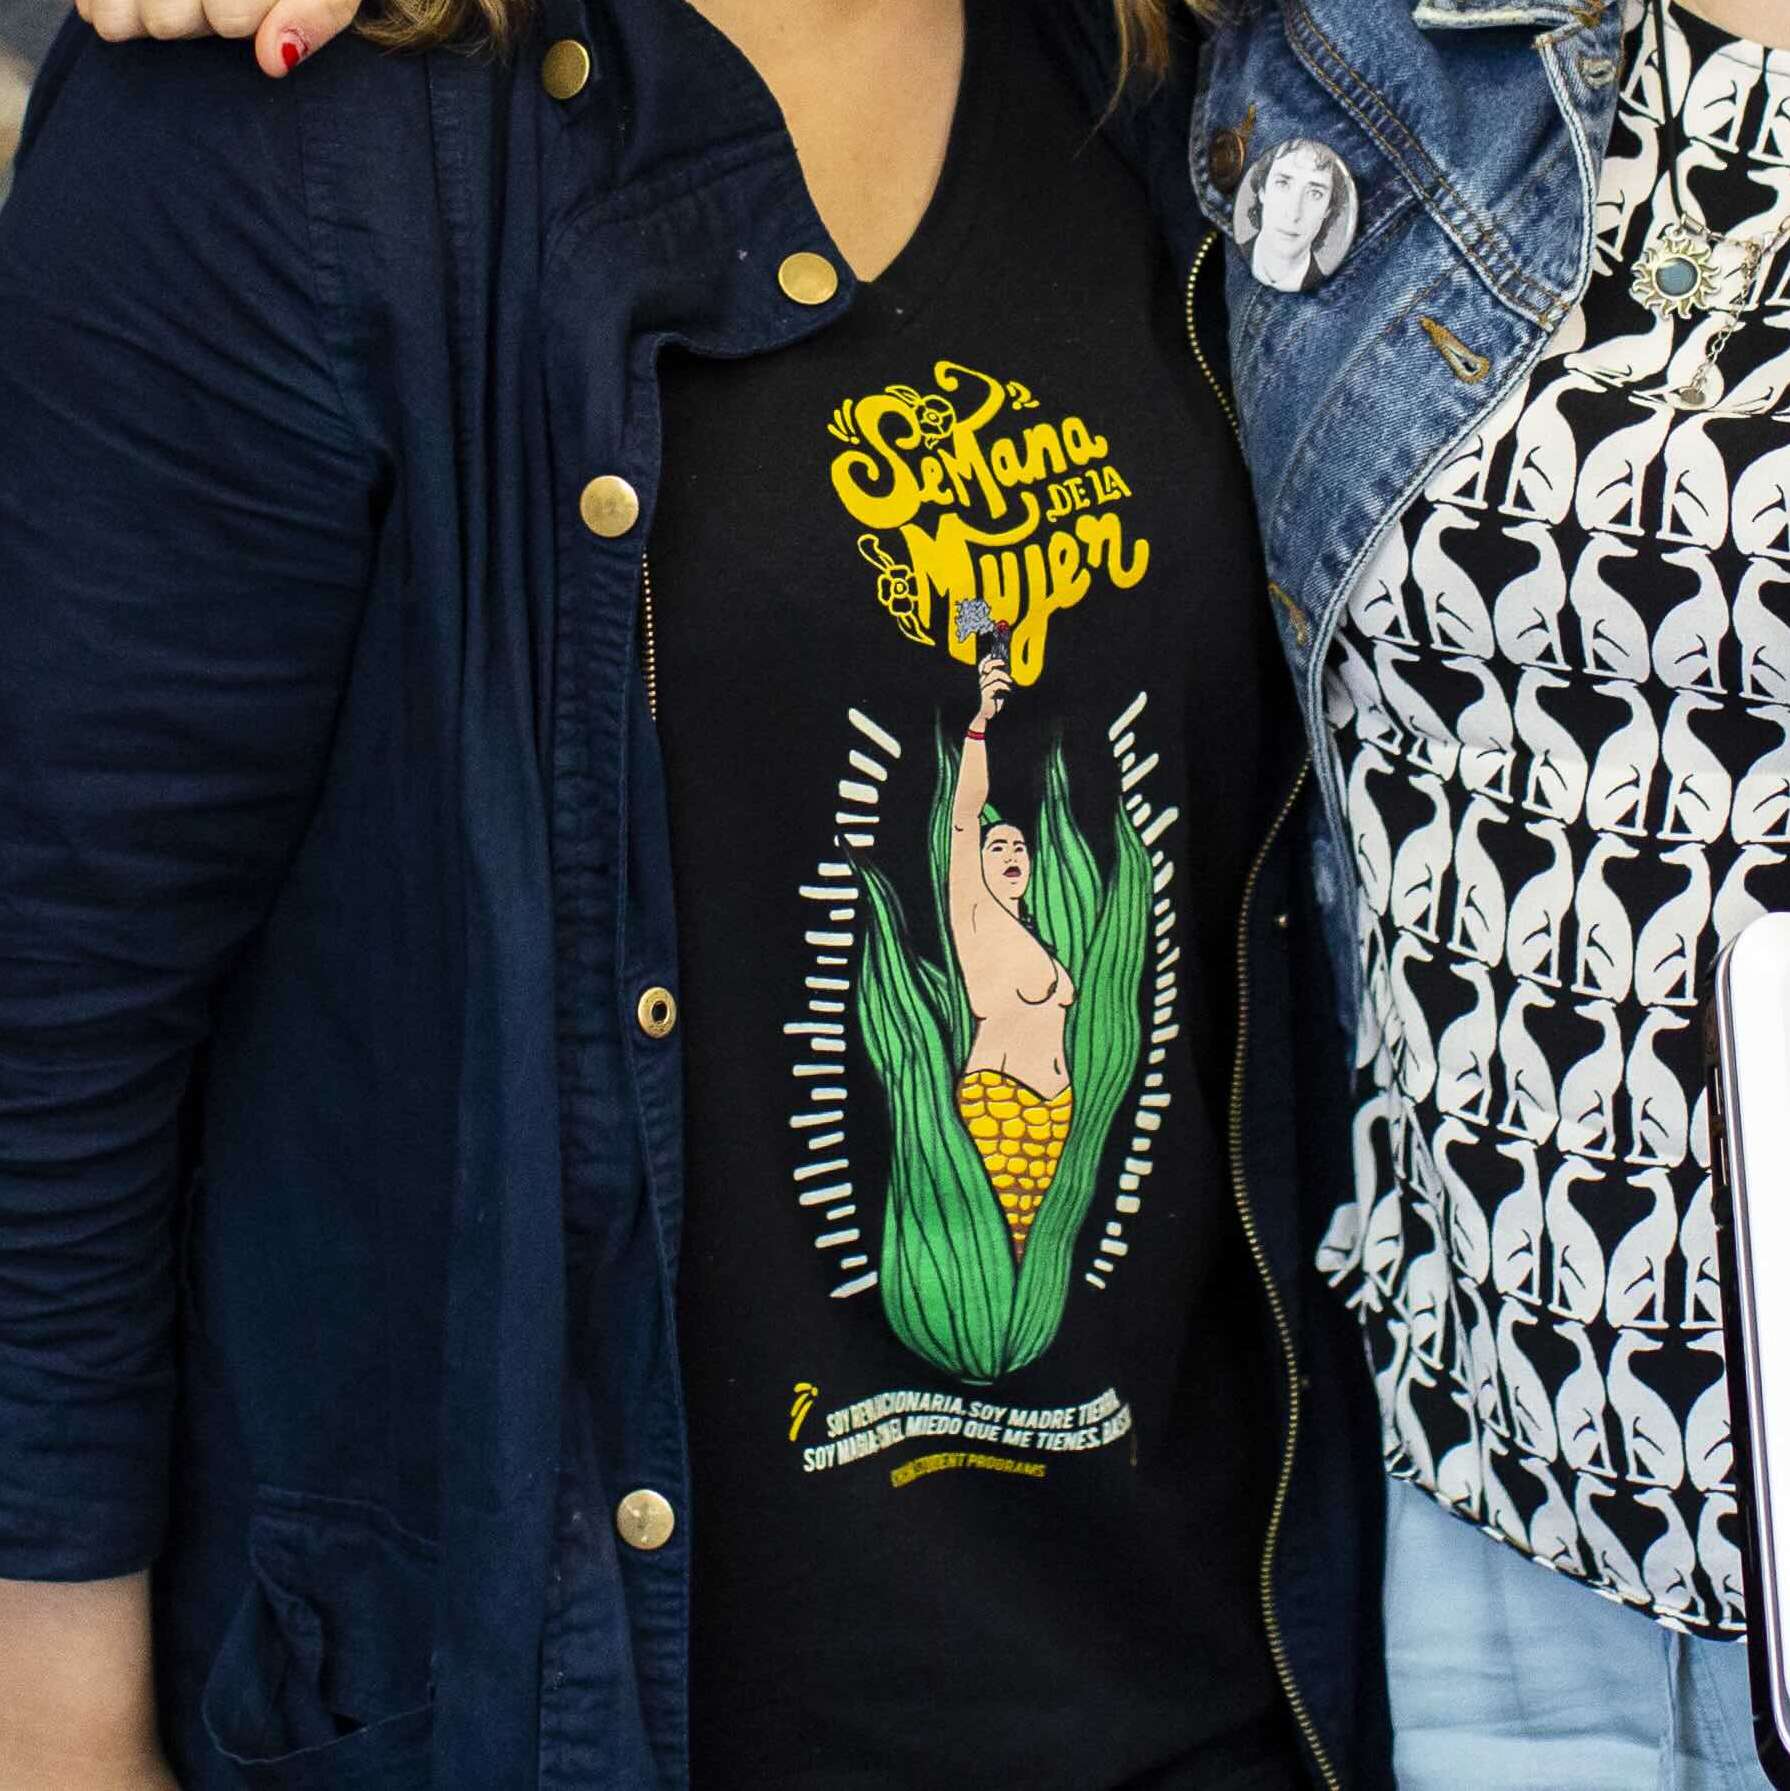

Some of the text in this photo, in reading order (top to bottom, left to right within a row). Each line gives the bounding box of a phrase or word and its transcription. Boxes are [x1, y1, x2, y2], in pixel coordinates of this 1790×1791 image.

[1047, 466, 1132, 522] DE LA
[967, 1401, 1007, 1423] SOY
[1006, 1408, 1076, 1429] MADRE
[803, 1444, 837, 1473] SOY
[905, 1416, 964, 1437] MIEDO
[963, 1420, 1003, 1441] QUE
[1002, 1428, 1035, 1449] ME
